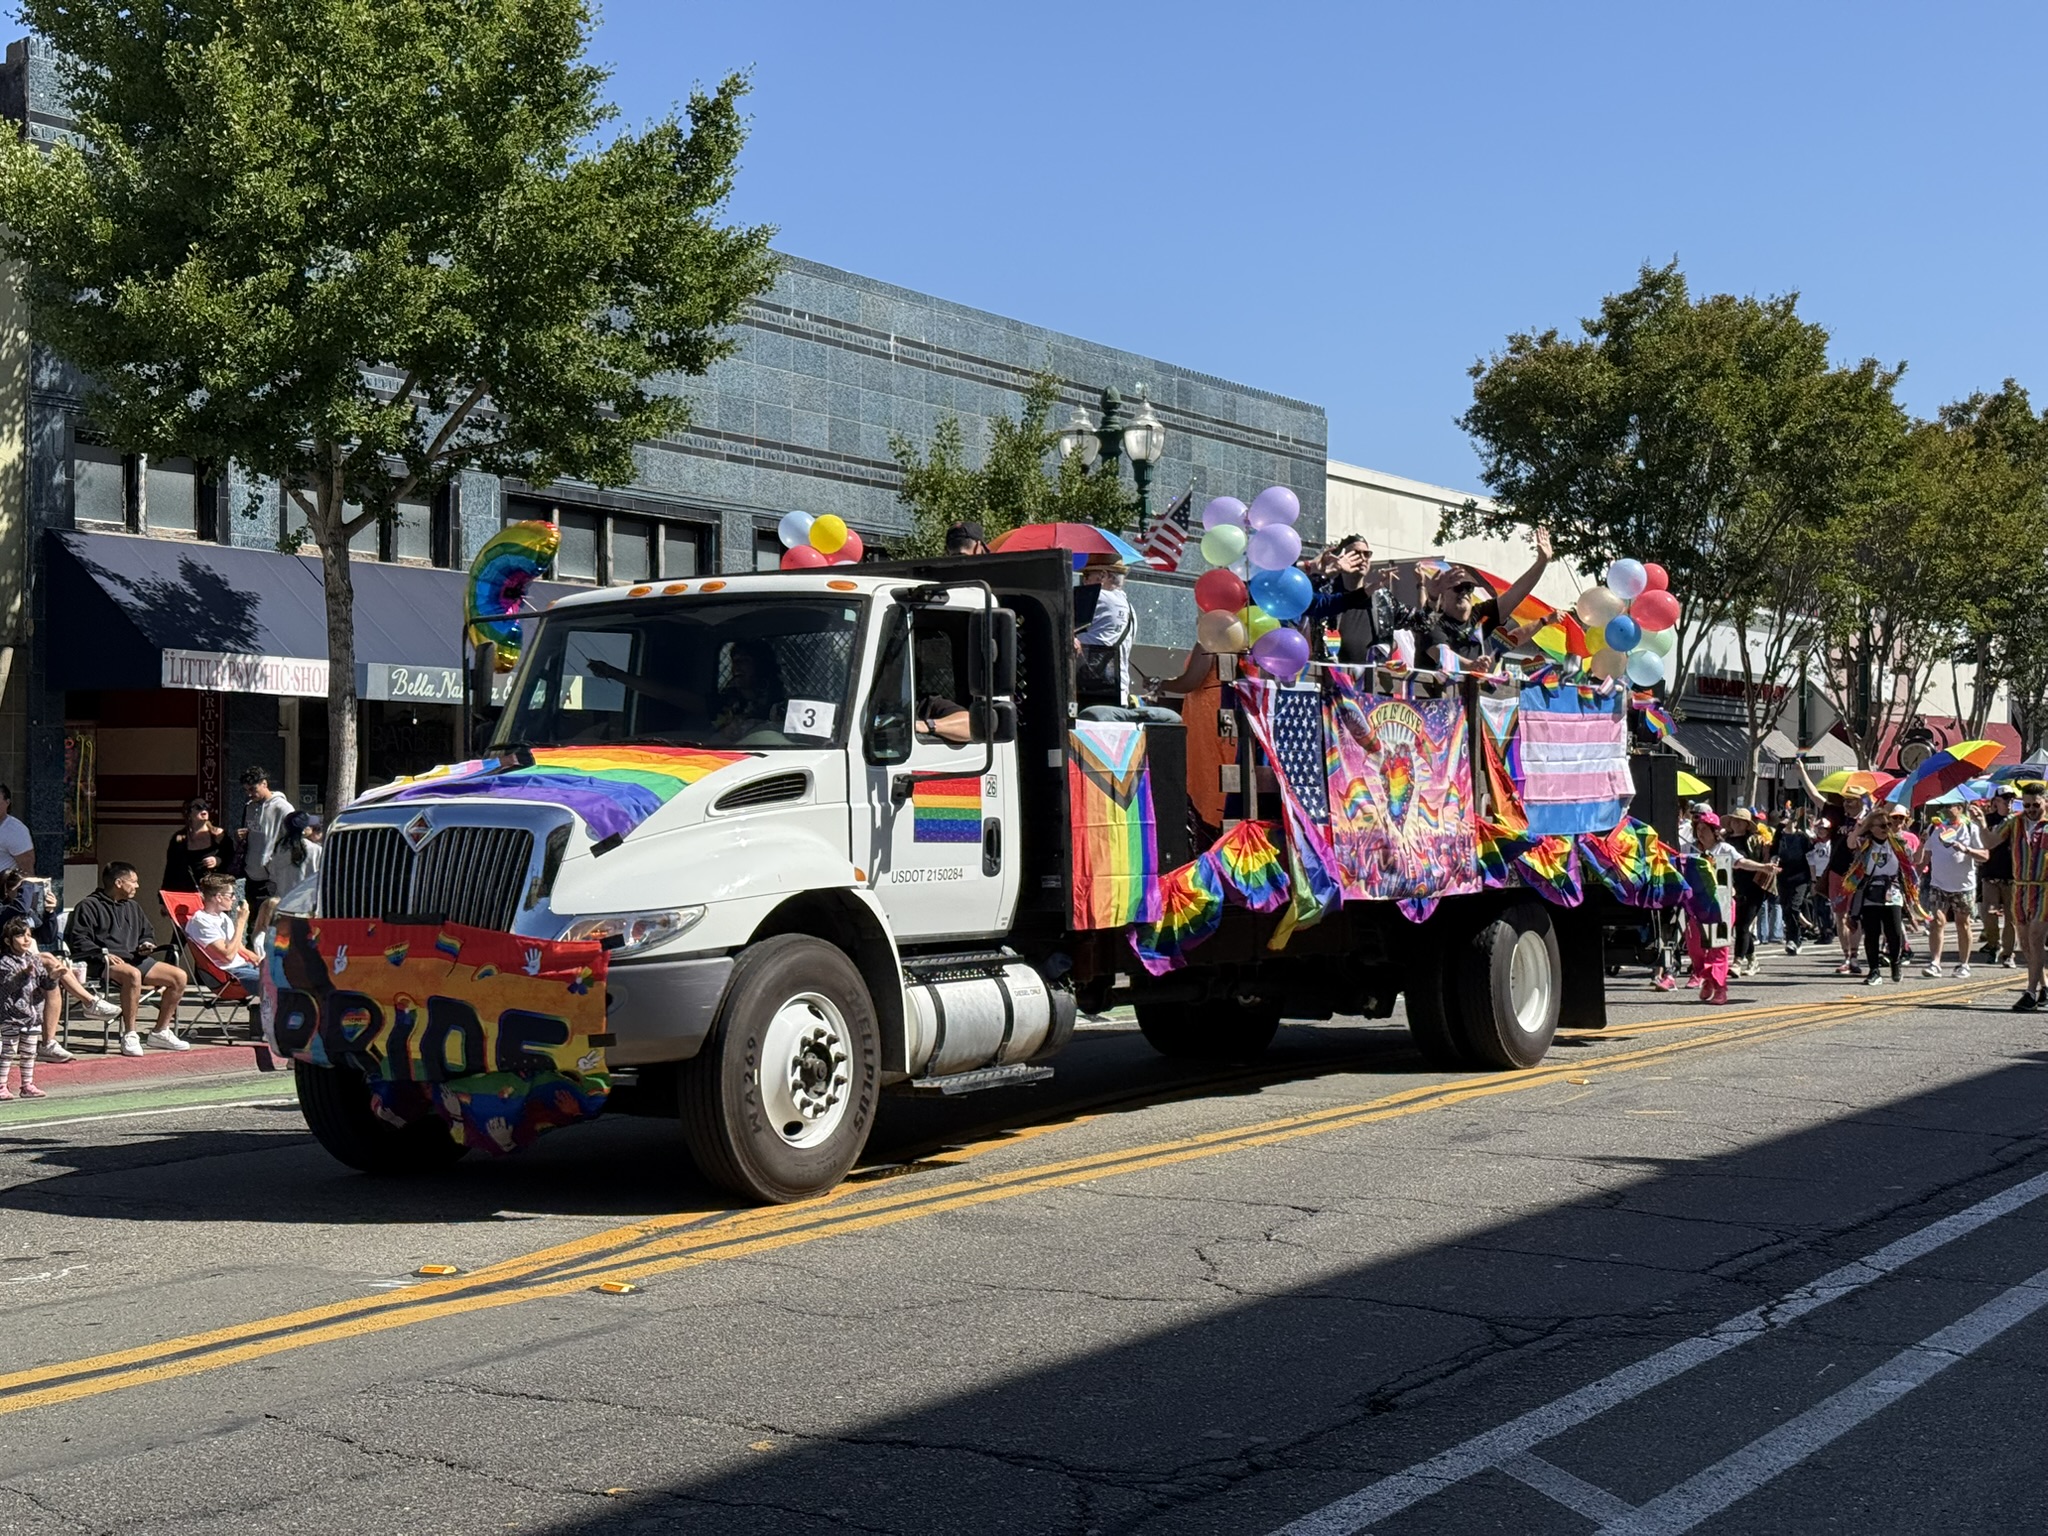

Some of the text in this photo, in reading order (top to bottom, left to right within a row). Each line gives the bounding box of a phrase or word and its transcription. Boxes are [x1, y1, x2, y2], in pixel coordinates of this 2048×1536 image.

[169, 656, 222, 687] LITTLE
[227, 660, 290, 692] PSYCHIC
[391, 668, 435, 696] Bella
[802, 708, 816, 728] 3
[1400, 706, 1422, 734] LOVE
[987, 780, 997, 795] 26
[891, 867, 963, 884] USDOT 2150284
[273, 987, 571, 1081] PRIDE
[744, 1036, 762, 1134] WA269
